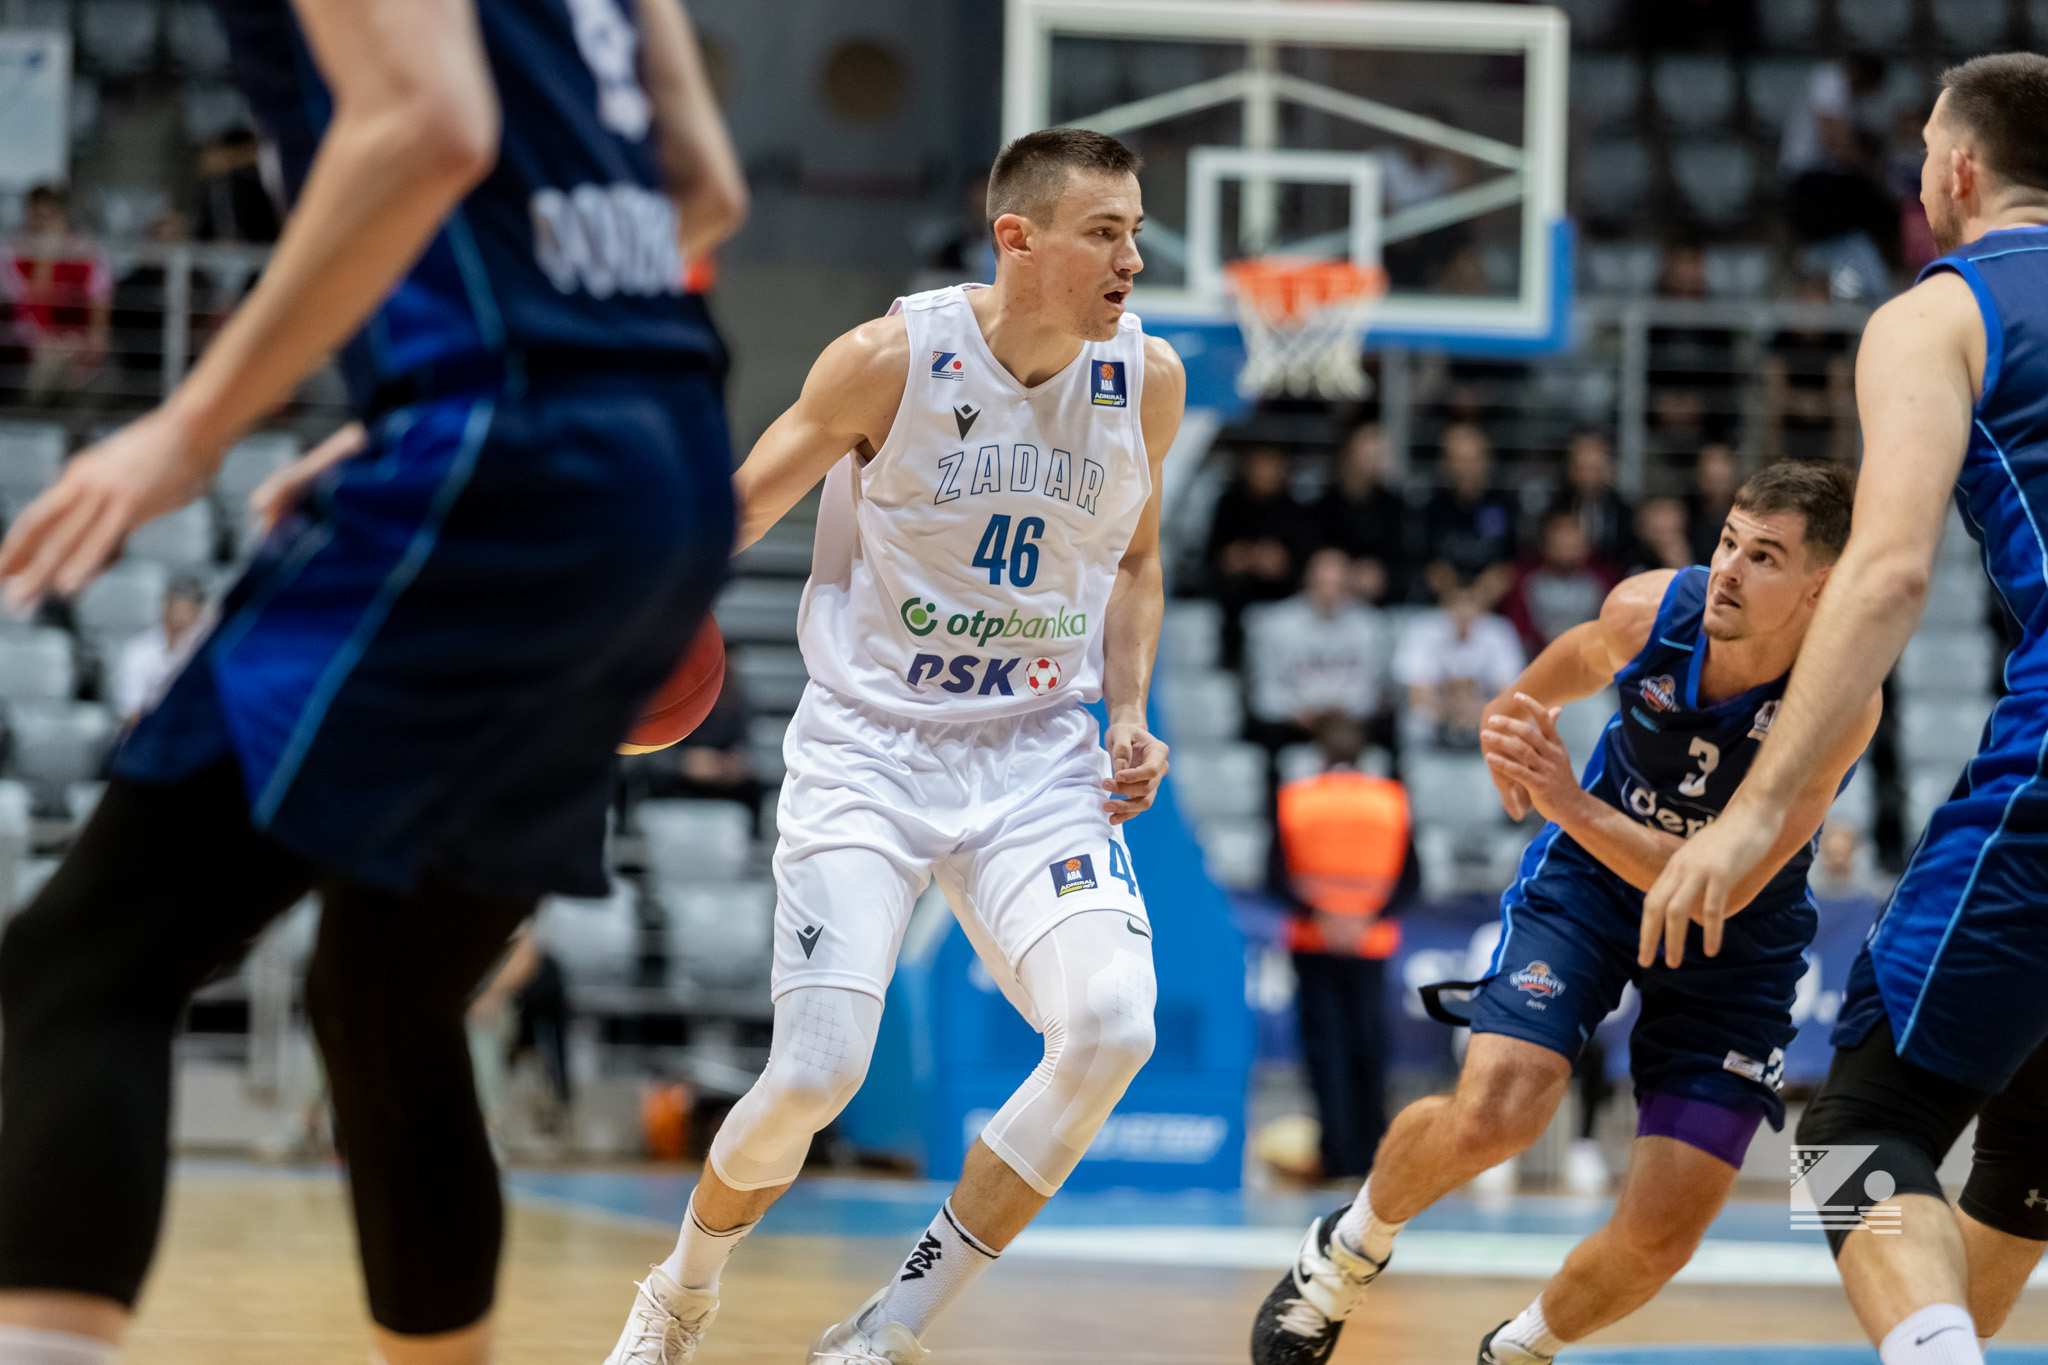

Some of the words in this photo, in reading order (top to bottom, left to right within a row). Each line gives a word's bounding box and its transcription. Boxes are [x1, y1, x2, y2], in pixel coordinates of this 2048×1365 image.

[1094, 392, 1124, 401] ADMIRAL
[934, 443, 1105, 516] ZADAR
[972, 513, 1046, 588] 46
[907, 653, 1022, 697] PSK
[1677, 735, 1720, 798] 3
[1060, 879, 1093, 892] ADMIRAL
